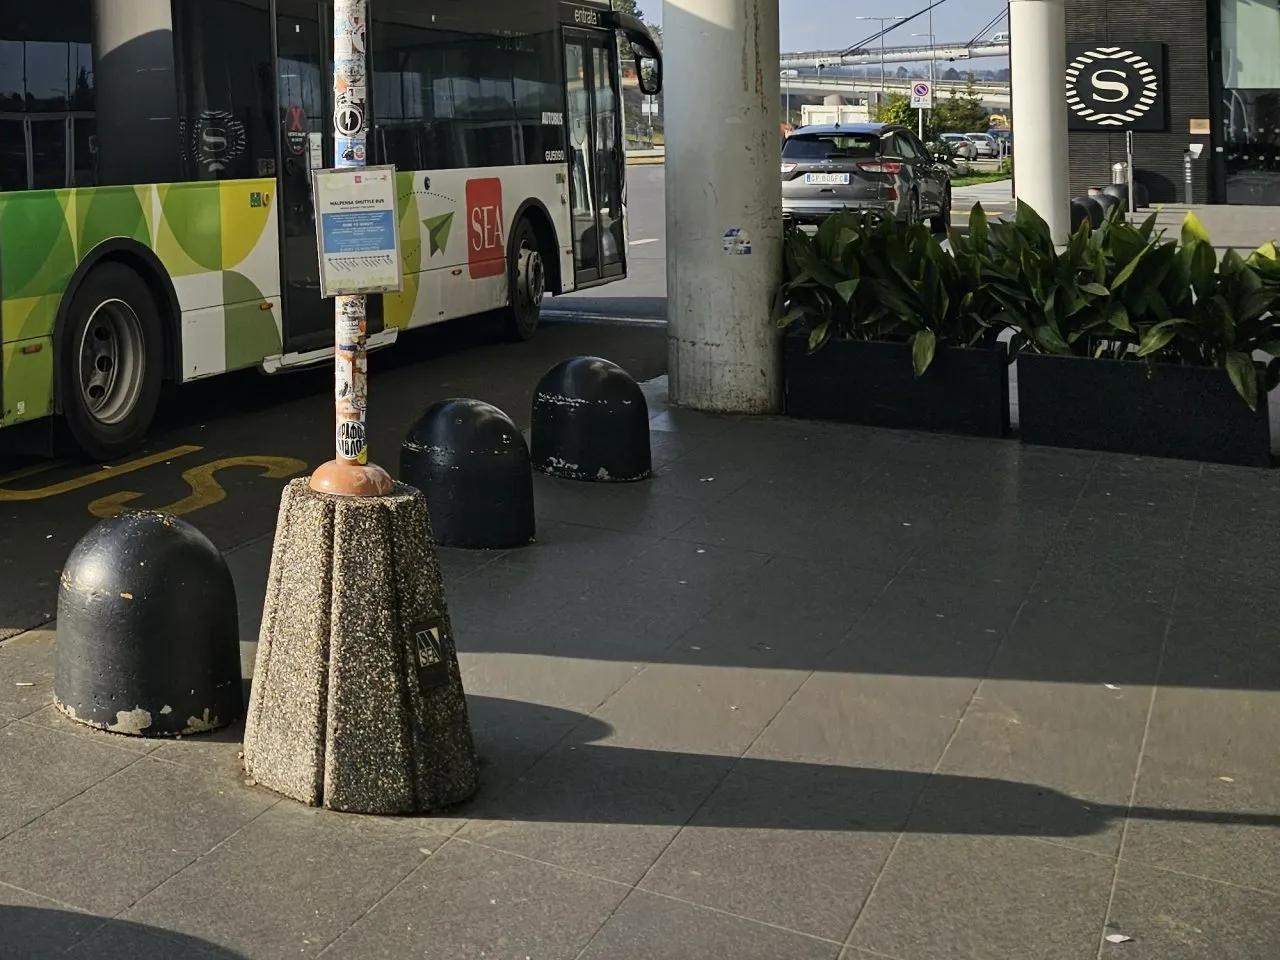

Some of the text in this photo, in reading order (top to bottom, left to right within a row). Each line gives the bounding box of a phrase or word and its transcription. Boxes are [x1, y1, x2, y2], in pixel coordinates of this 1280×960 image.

[575, 8, 597, 24] entrata
[1091, 69, 1129, 103] S
[472, 205, 504, 251] SEA
